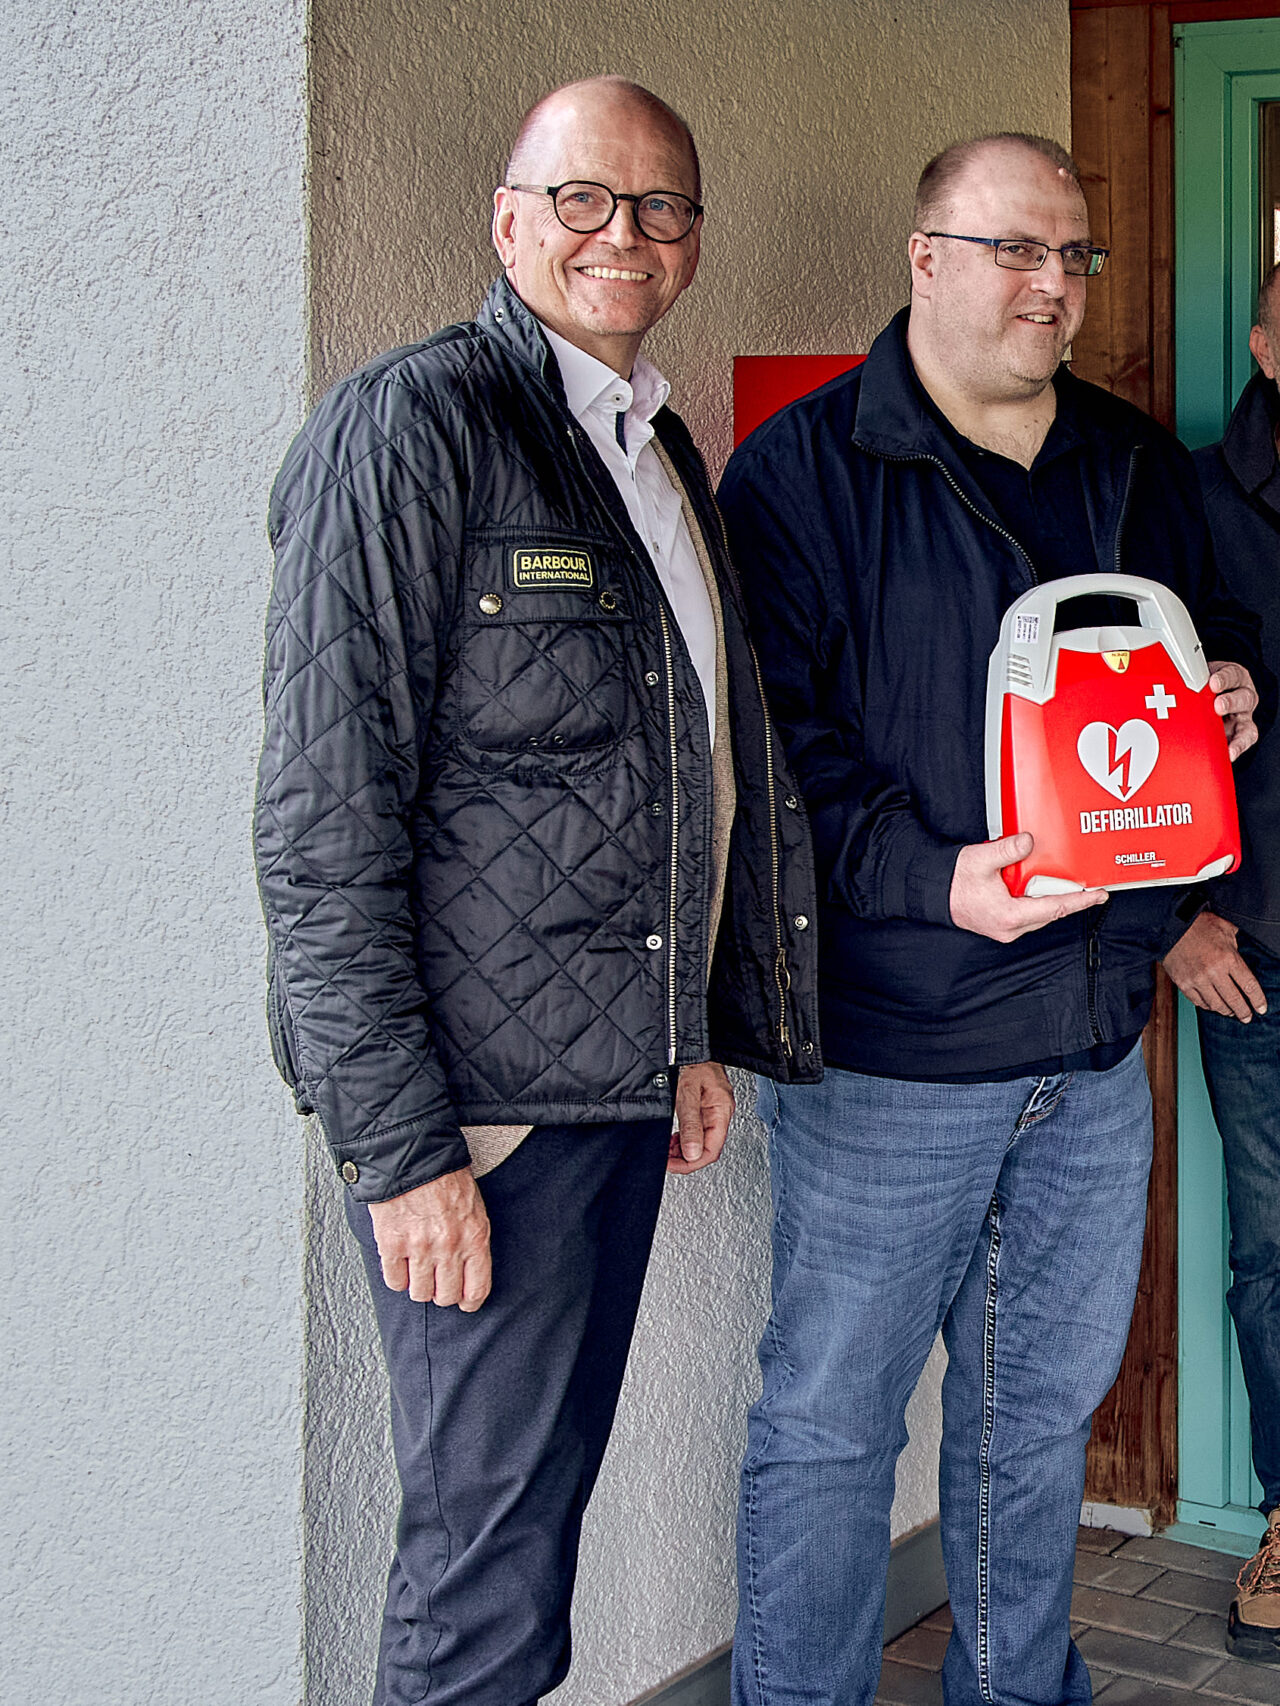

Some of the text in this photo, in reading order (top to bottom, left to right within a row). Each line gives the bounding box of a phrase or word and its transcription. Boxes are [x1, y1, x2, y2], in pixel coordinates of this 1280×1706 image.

[520, 556, 587, 571] BARBOUR
[519, 571, 590, 581] INTERNATIONAL
[1080, 803, 1193, 834] DEFIBRILLATOR
[1115, 851, 1156, 865] SCHILLER
